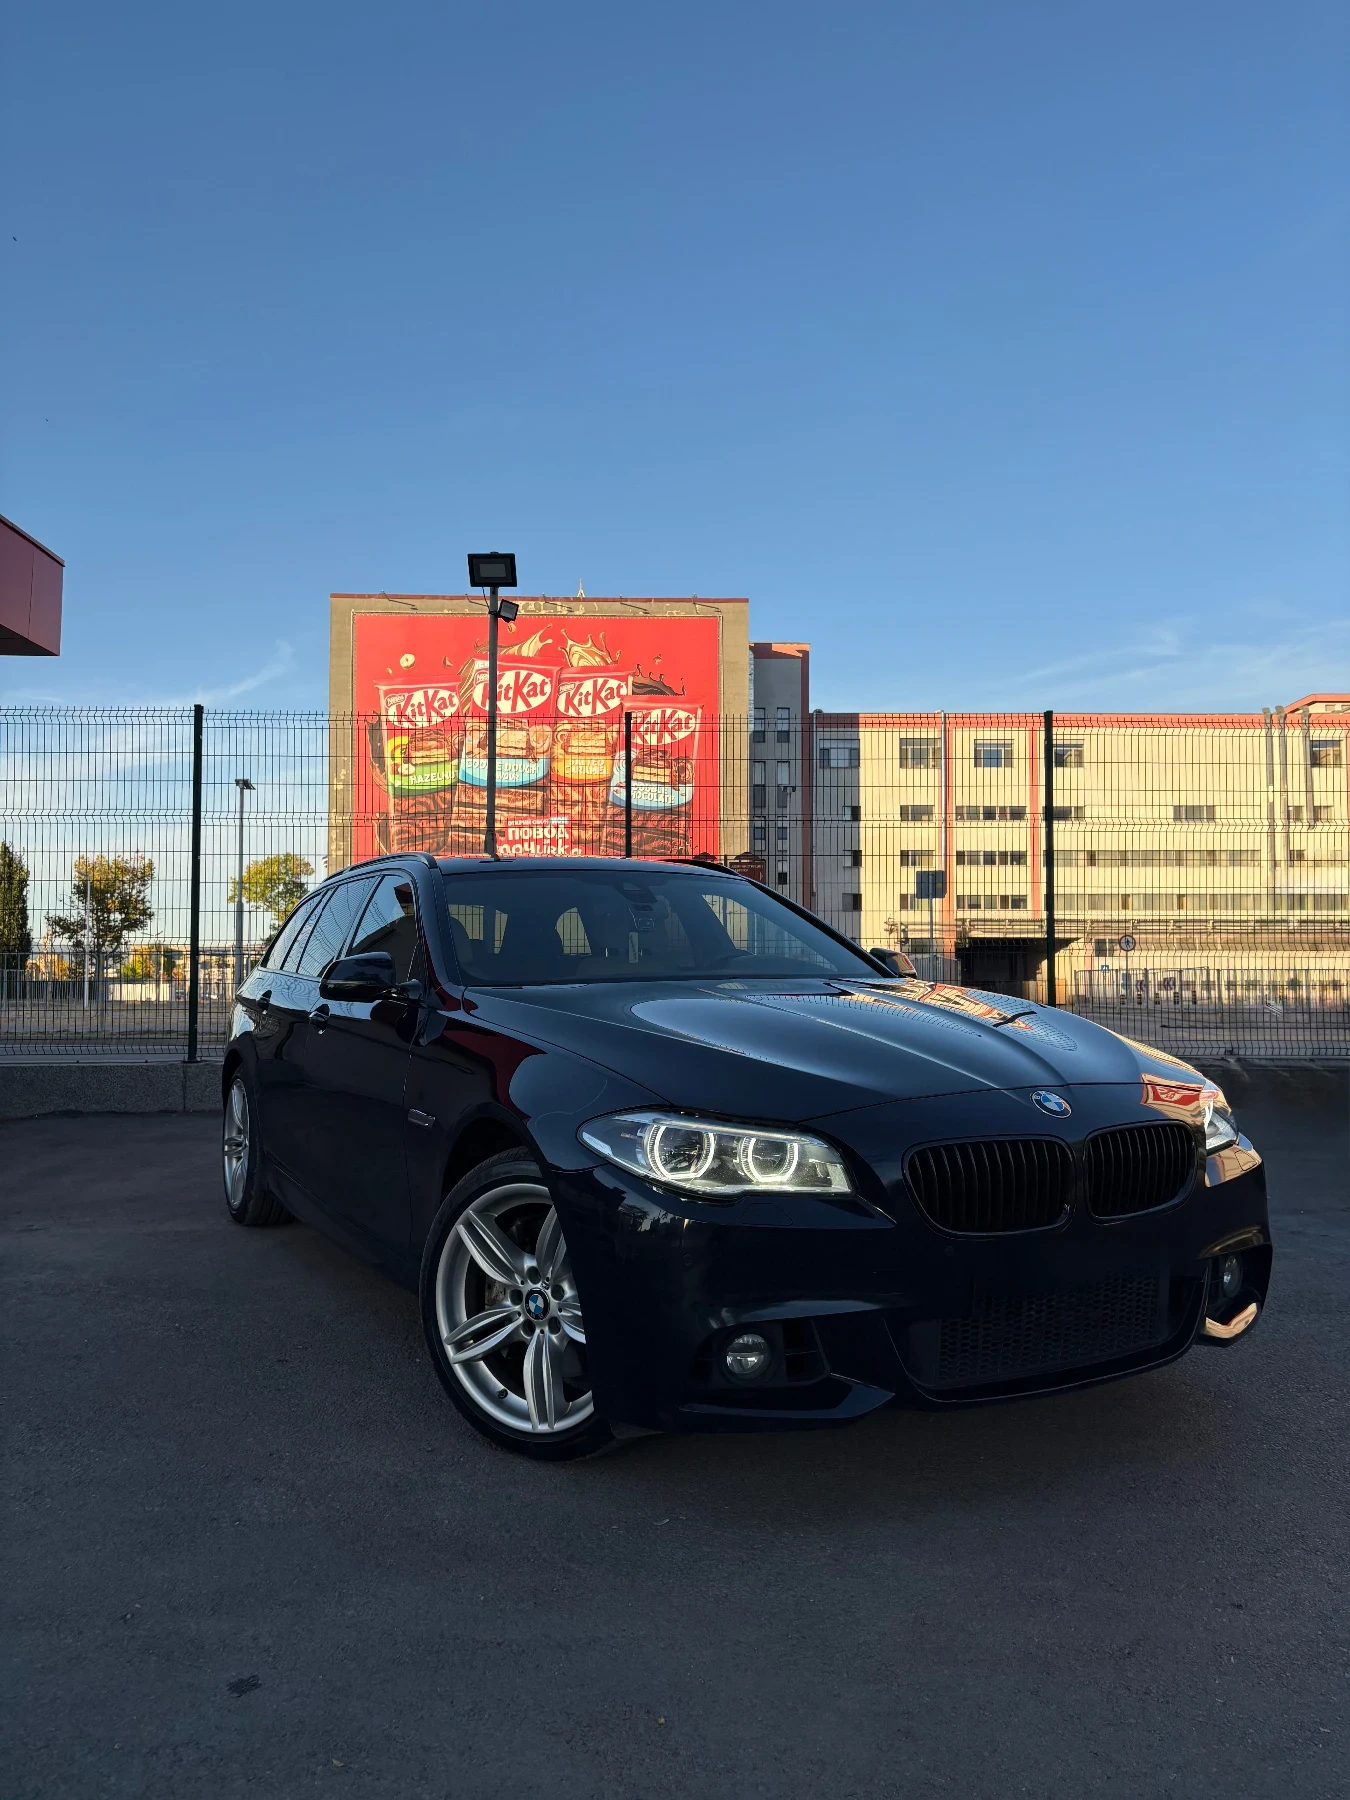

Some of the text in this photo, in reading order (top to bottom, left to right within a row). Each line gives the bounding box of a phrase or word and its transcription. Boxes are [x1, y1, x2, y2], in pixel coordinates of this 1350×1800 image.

[564, 679, 623, 715] KitKat
[395, 690, 456, 727] KitKat
[631, 709, 692, 744] KitKat
[467, 760, 539, 774] COOE DOUGH
[565, 765, 607, 775] CARAMEL
[632, 784, 668, 795] DOUBLE
[508, 825, 569, 840] ПОВОД
